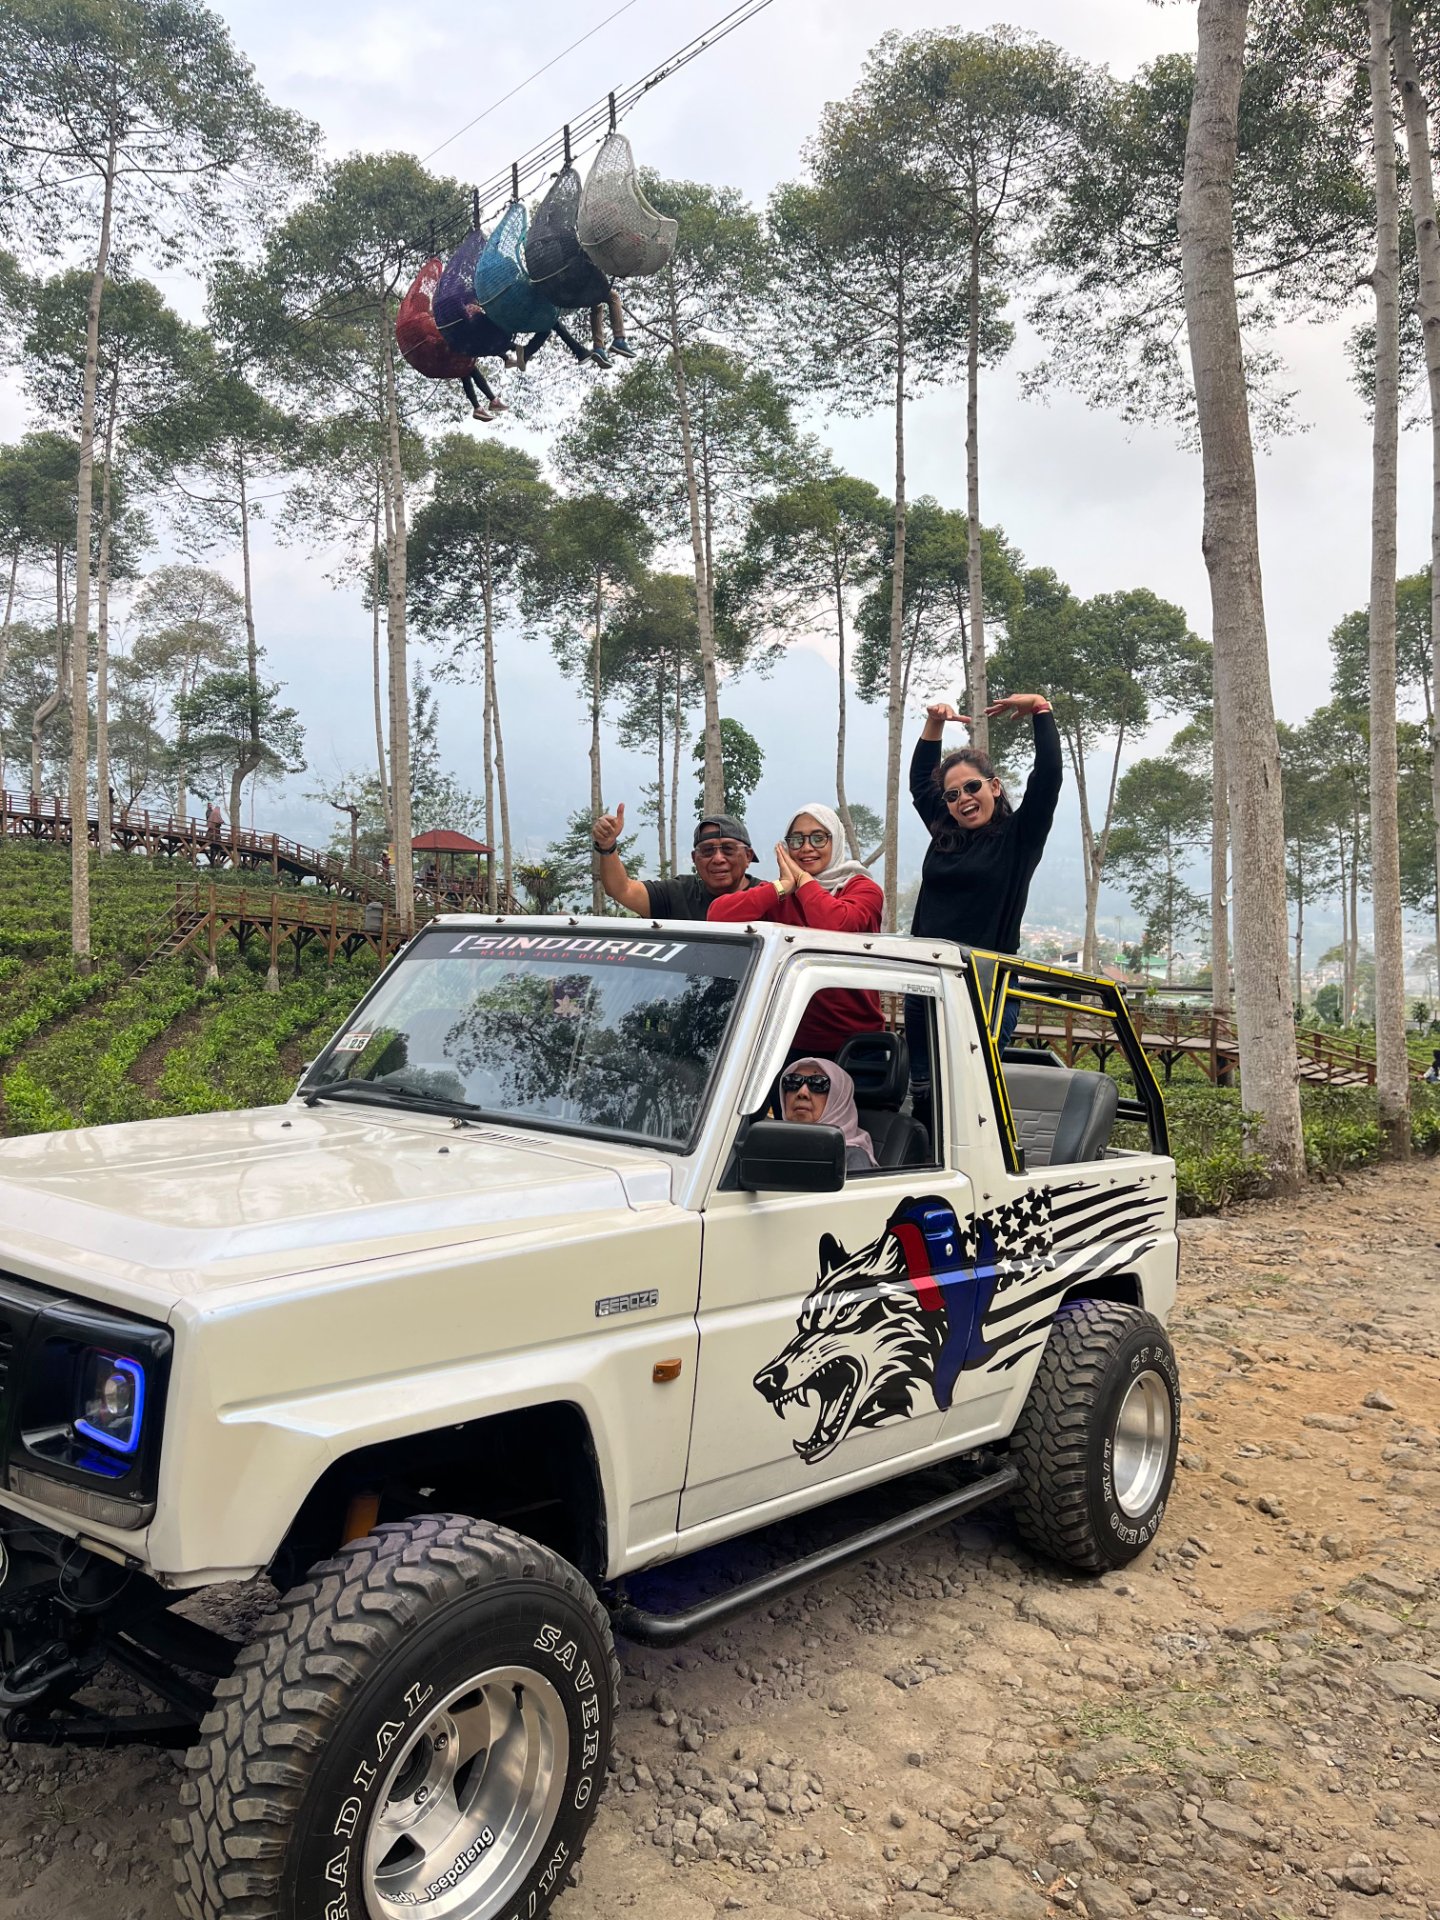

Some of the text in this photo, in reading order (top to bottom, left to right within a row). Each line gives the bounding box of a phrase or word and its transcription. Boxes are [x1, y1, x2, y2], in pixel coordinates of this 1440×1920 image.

[480, 949, 526, 958] READY
[1131, 1346, 1181, 1436] GT RADIAL
[1110, 1500, 1164, 1545] SAVERO
[324, 1681, 433, 1920] RADIAL
[511, 1624, 600, 1920] SAVERO M/
